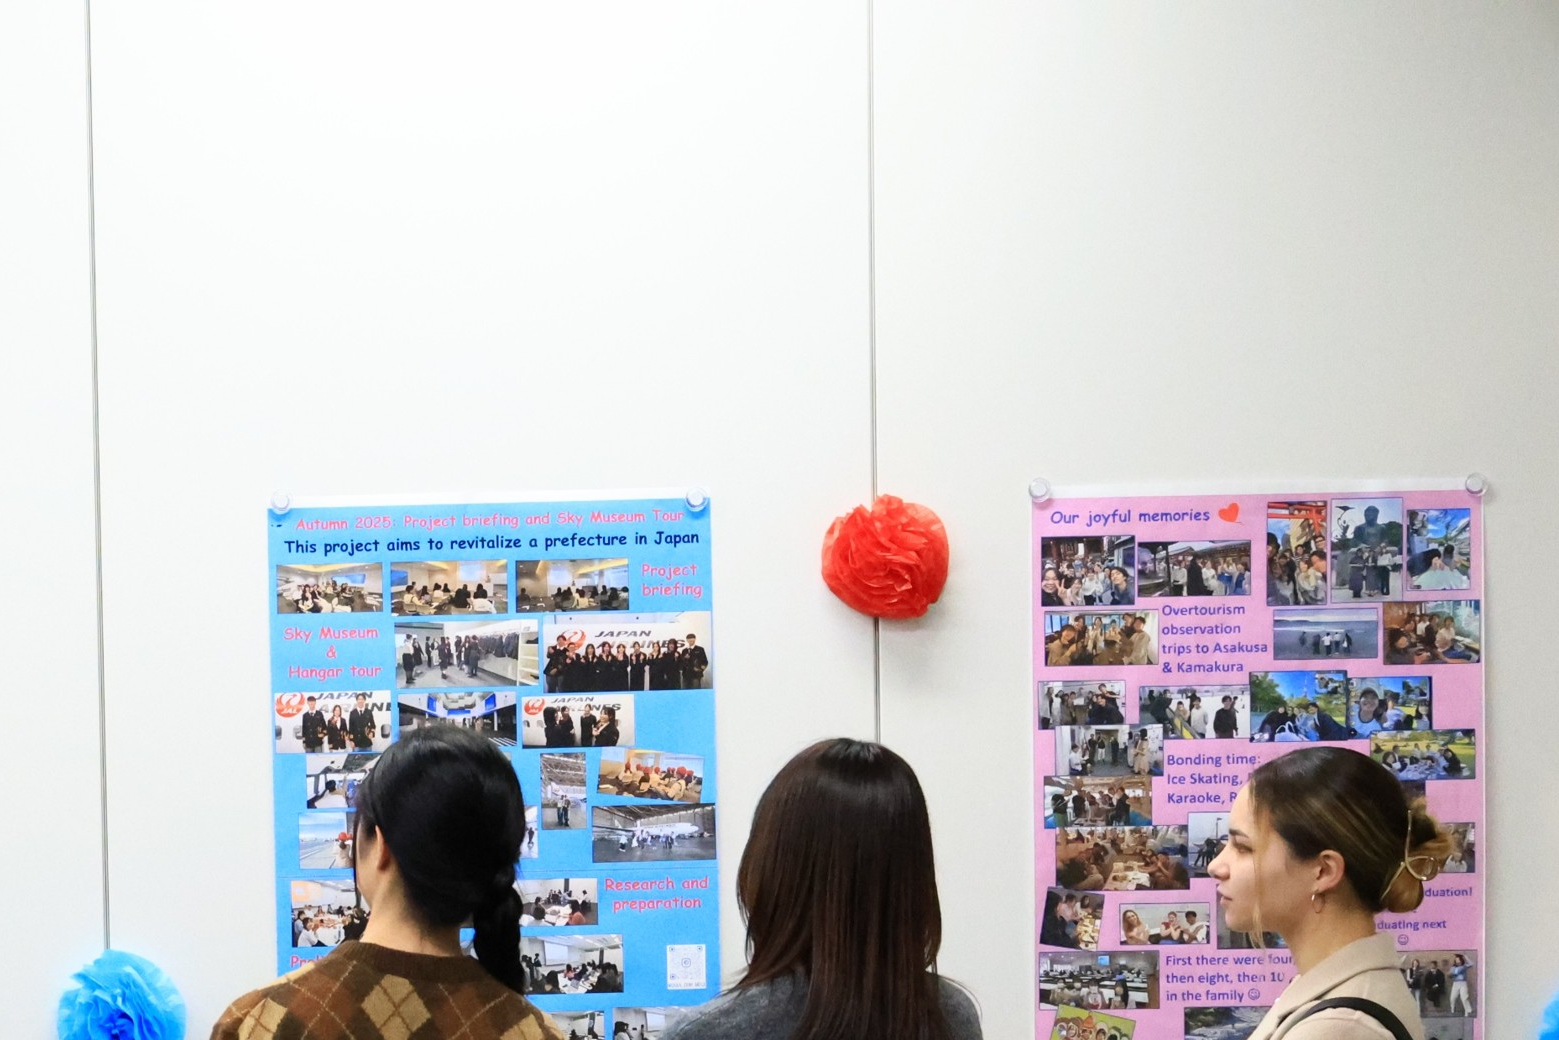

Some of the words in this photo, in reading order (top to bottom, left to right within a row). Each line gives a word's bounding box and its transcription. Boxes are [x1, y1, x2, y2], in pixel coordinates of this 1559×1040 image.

[295, 518, 348, 531] Autumn
[355, 516, 397, 529] 2025:
[404, 515, 456, 531] Project
[462, 512, 519, 529] briefing
[525, 512, 550, 525] and
[556, 511, 583, 528] Sky
[590, 510, 646, 524] Museum
[652, 509, 685, 522] Tour
[1050, 511, 1079, 524] Our
[1086, 509, 1131, 527] joyful
[1138, 509, 1211, 523] memories
[284, 540, 317, 553] This
[324, 539, 380, 556] project
[386, 539, 420, 552] aims
[427, 538, 444, 550] to
[450, 535, 522, 550] revitalize
[529, 538, 538, 548] a
[545, 533, 627, 551] prefecture
[634, 532, 647, 545] in
[654, 531, 700, 548] Japan
[642, 563, 697, 580] Project
[642, 581, 702, 598] briefing
[1161, 604, 1245, 616] Overtourism
[283, 627, 312, 643] Sky
[319, 627, 379, 639] Museum
[595, 630, 652, 638] JAPAN
[1161, 624, 1241, 635] observation
[326, 645, 337, 659] &
[1161, 643, 1192, 657] trips
[1196, 644, 1209, 654] to
[1213, 641, 1268, 653] Asakusa
[288, 665, 343, 682] Hangar
[350, 665, 382, 677] tour
[1162, 662, 1172, 673] &
[1177, 661, 1244, 673] Kamakura
[1167, 754, 1222, 767] Bonding
[1226, 754, 1261, 765] time:
[1167, 773, 1186, 784] Ice
[1190, 773, 1243, 786] Skating,
[1167, 792, 1225, 805] Karaoke,
[605, 877, 675, 891] Research
[682, 875, 709, 889] and
[1424, 887, 1473, 898] duation!
[613, 896, 702, 914] preparation
[1377, 920, 1420, 931] duating
[1422, 920, 1447, 929] next
[1166, 955, 1192, 966] First
[1196, 955, 1229, 965] there
[1232, 957, 1264, 965] were
[1166, 973, 1195, 983] then
[1198, 972, 1233, 986] eight,
[1237, 972, 1266, 982] then
[1166, 991, 1177, 1001] in
[1181, 990, 1202, 1001] the
[1206, 990, 1244, 1003] family
